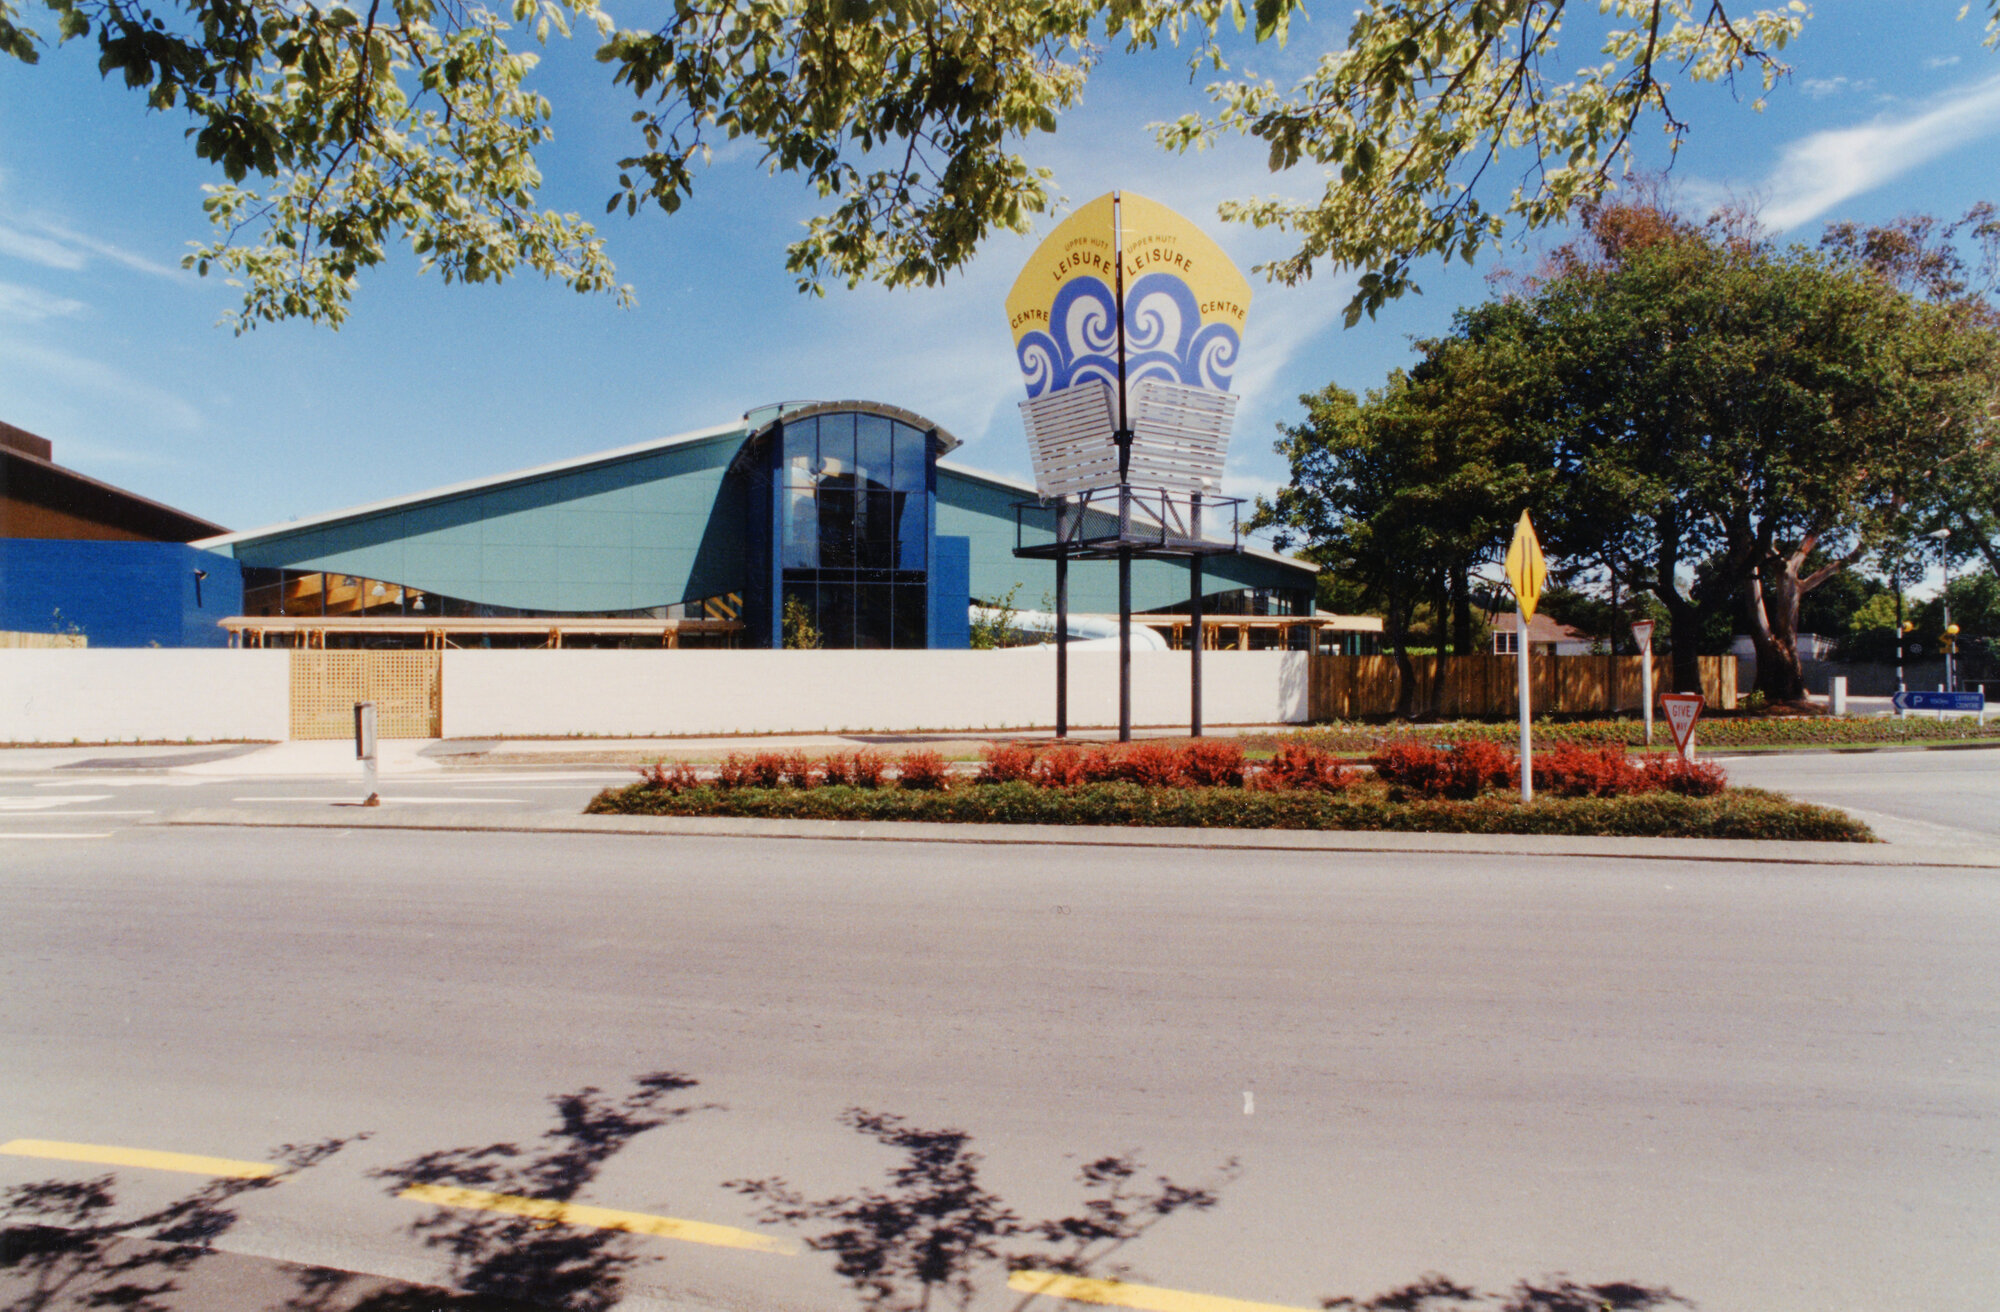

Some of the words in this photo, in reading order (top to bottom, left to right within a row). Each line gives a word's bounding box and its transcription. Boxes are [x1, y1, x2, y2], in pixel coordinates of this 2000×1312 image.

[1065, 237, 1088, 252] UPPER
[1090, 237, 1109, 250] HUTT
[1053, 251, 1111, 281] LEISURE
[1127, 248, 1192, 276] LEISURE
[1011, 309, 1049, 329] CENTRE
[1201, 301, 1245, 320] CENTRE
[1913, 695, 1924, 707] P
[1672, 705, 1691, 717] GIVE
[1676, 722, 1688, 731] WAY
